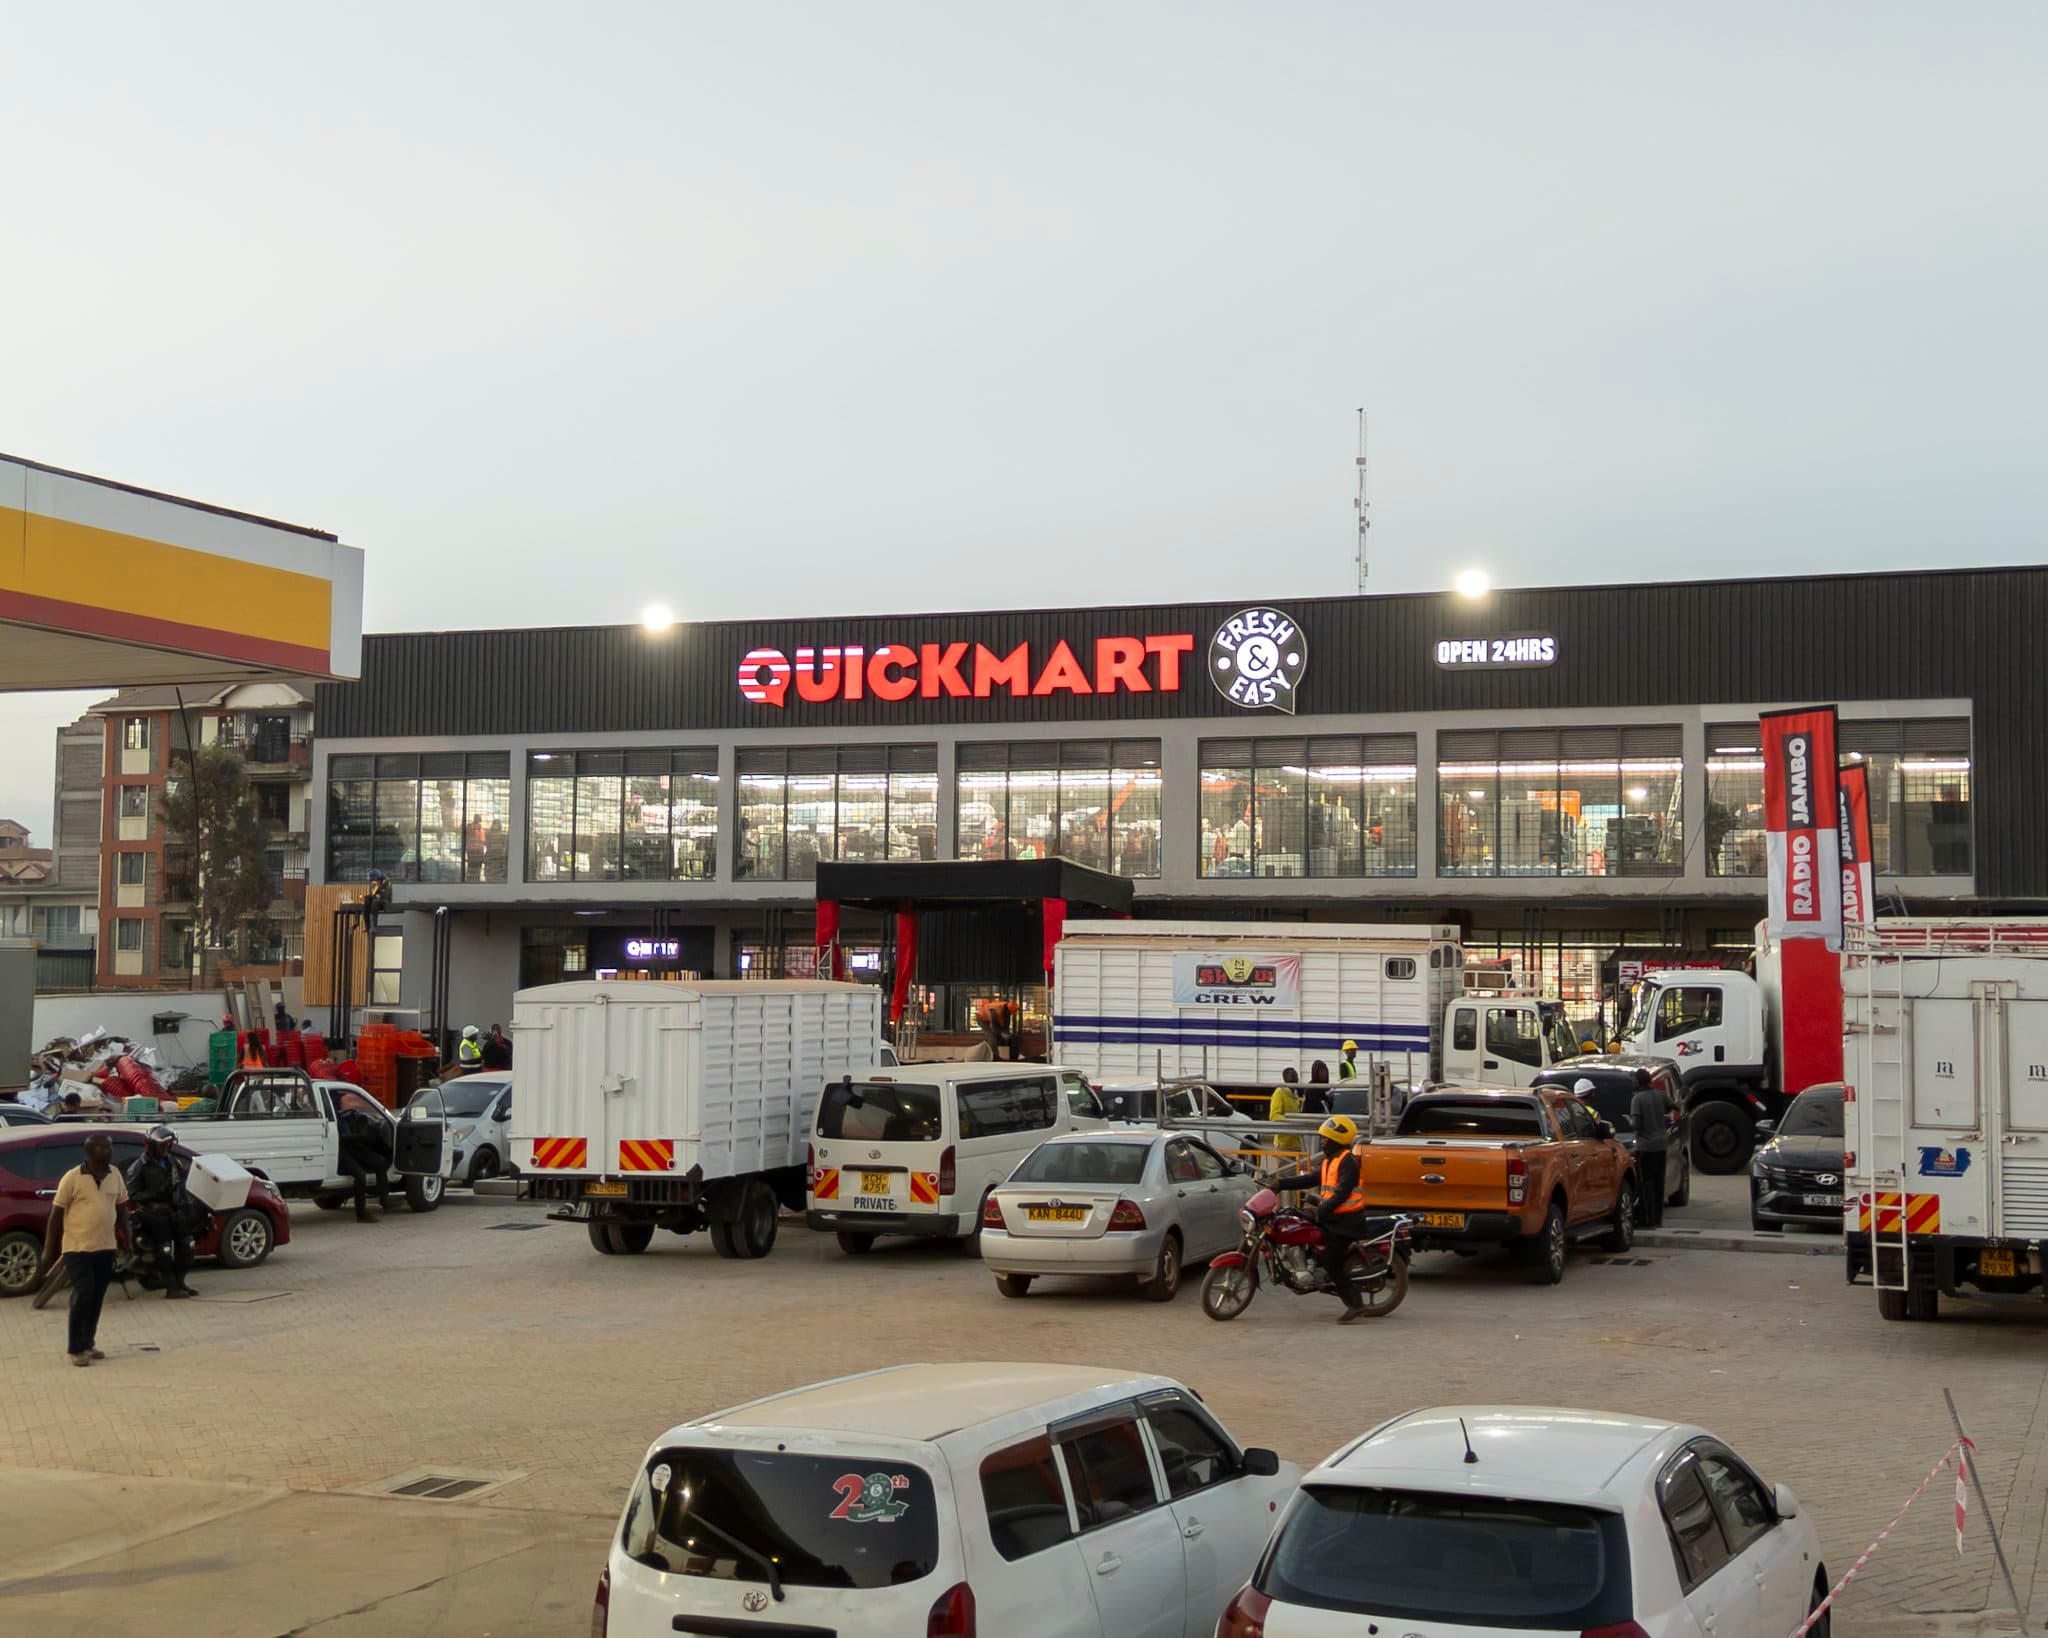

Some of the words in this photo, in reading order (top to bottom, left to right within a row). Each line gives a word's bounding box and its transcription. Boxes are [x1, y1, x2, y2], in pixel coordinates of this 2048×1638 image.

[1216, 610, 1295, 651] FRESH
[1247, 643, 1270, 672] &
[1437, 640, 1488, 664] OPEN
[1491, 637, 1555, 662] 24HRS
[738, 633, 1195, 708] QUICKMART
[1229, 669, 1292, 705] EASY
[1788, 737, 1809, 825] JAMBO
[1792, 835, 1813, 916] RADIO
[1195, 993, 1276, 1005] CREW
[853, 1197, 895, 1210] PRIVATE
[1028, 1208, 1051, 1220] KAN
